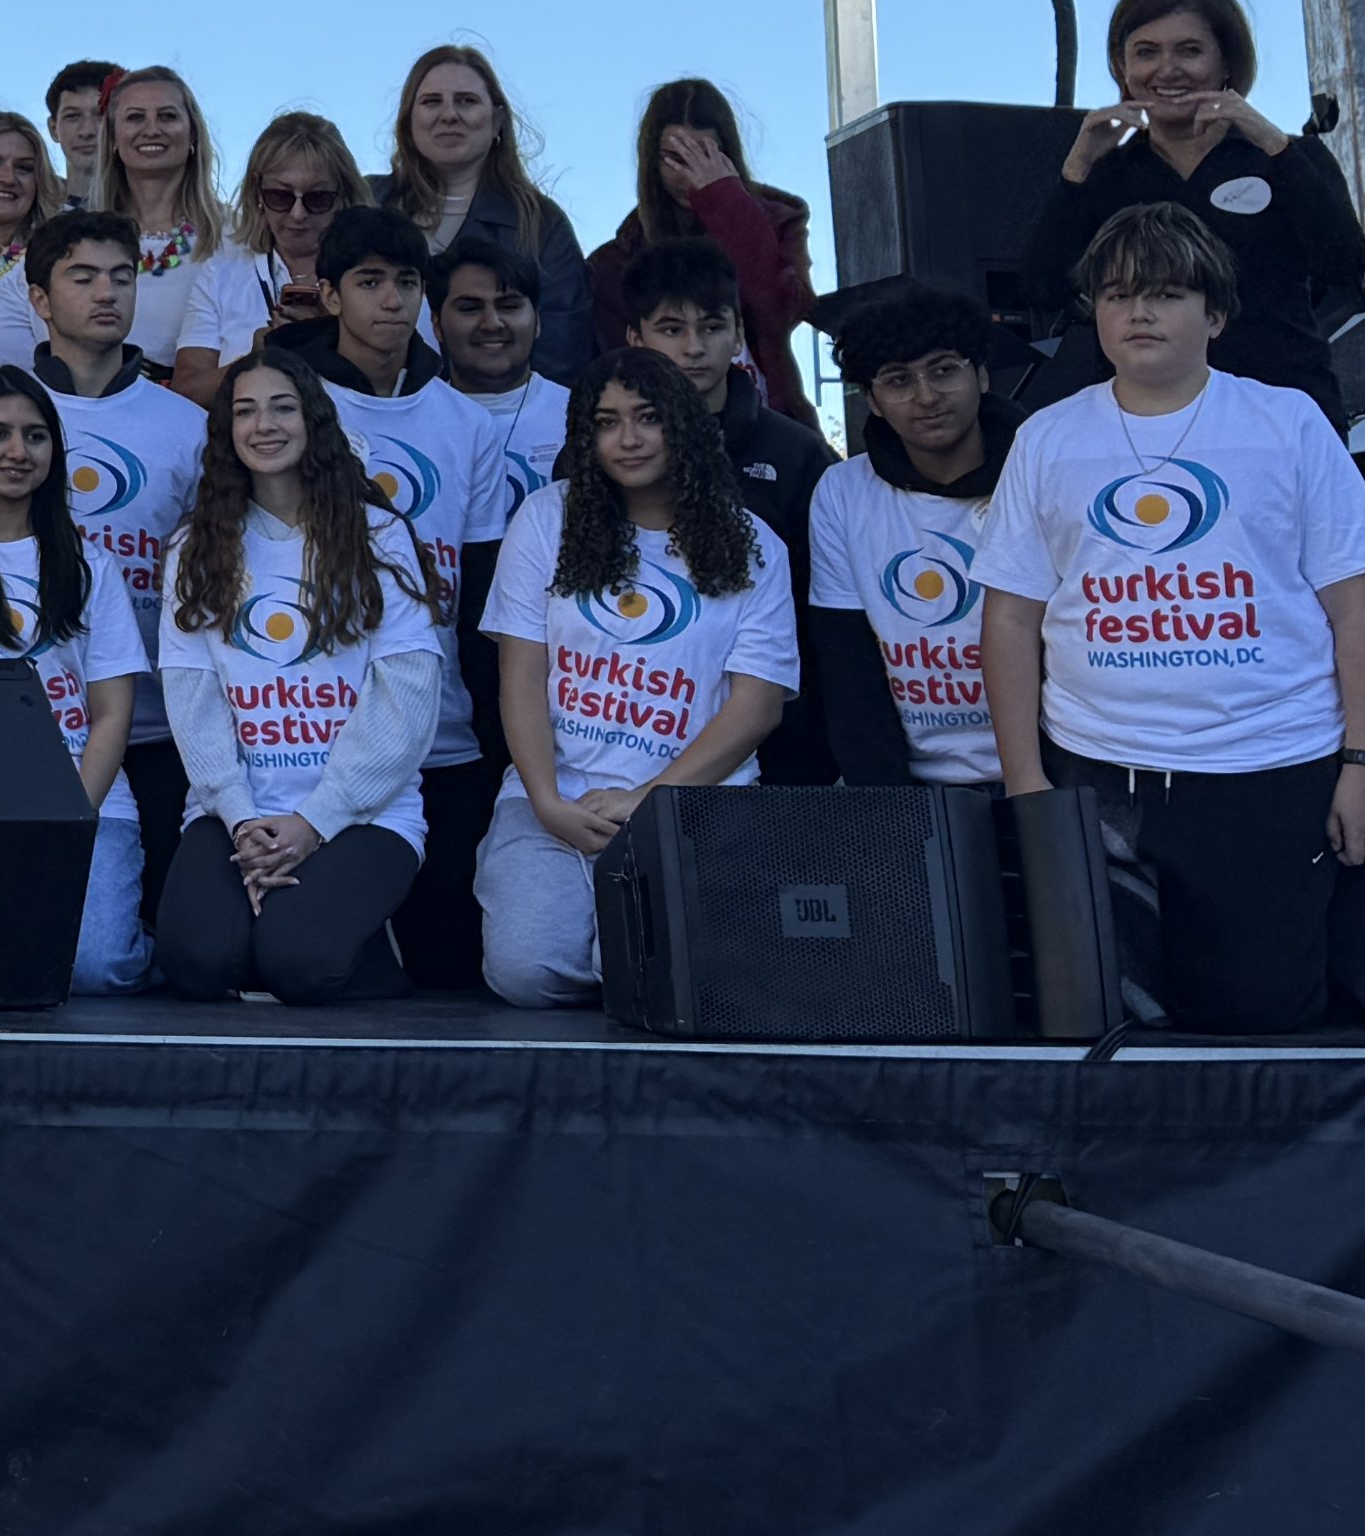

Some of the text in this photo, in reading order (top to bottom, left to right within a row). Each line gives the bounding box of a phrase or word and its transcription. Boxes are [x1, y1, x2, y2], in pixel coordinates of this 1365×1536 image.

[1082, 562, 1254, 604] turkish
[1085, 602, 1262, 643] festival
[881, 636, 983, 670] urkis
[557, 645, 696, 704] turkish
[890, 672, 983, 705] estiv
[558, 676, 690, 741] festival
[239, 711, 348, 747] estiv
[794, 898, 837, 923] JBL
